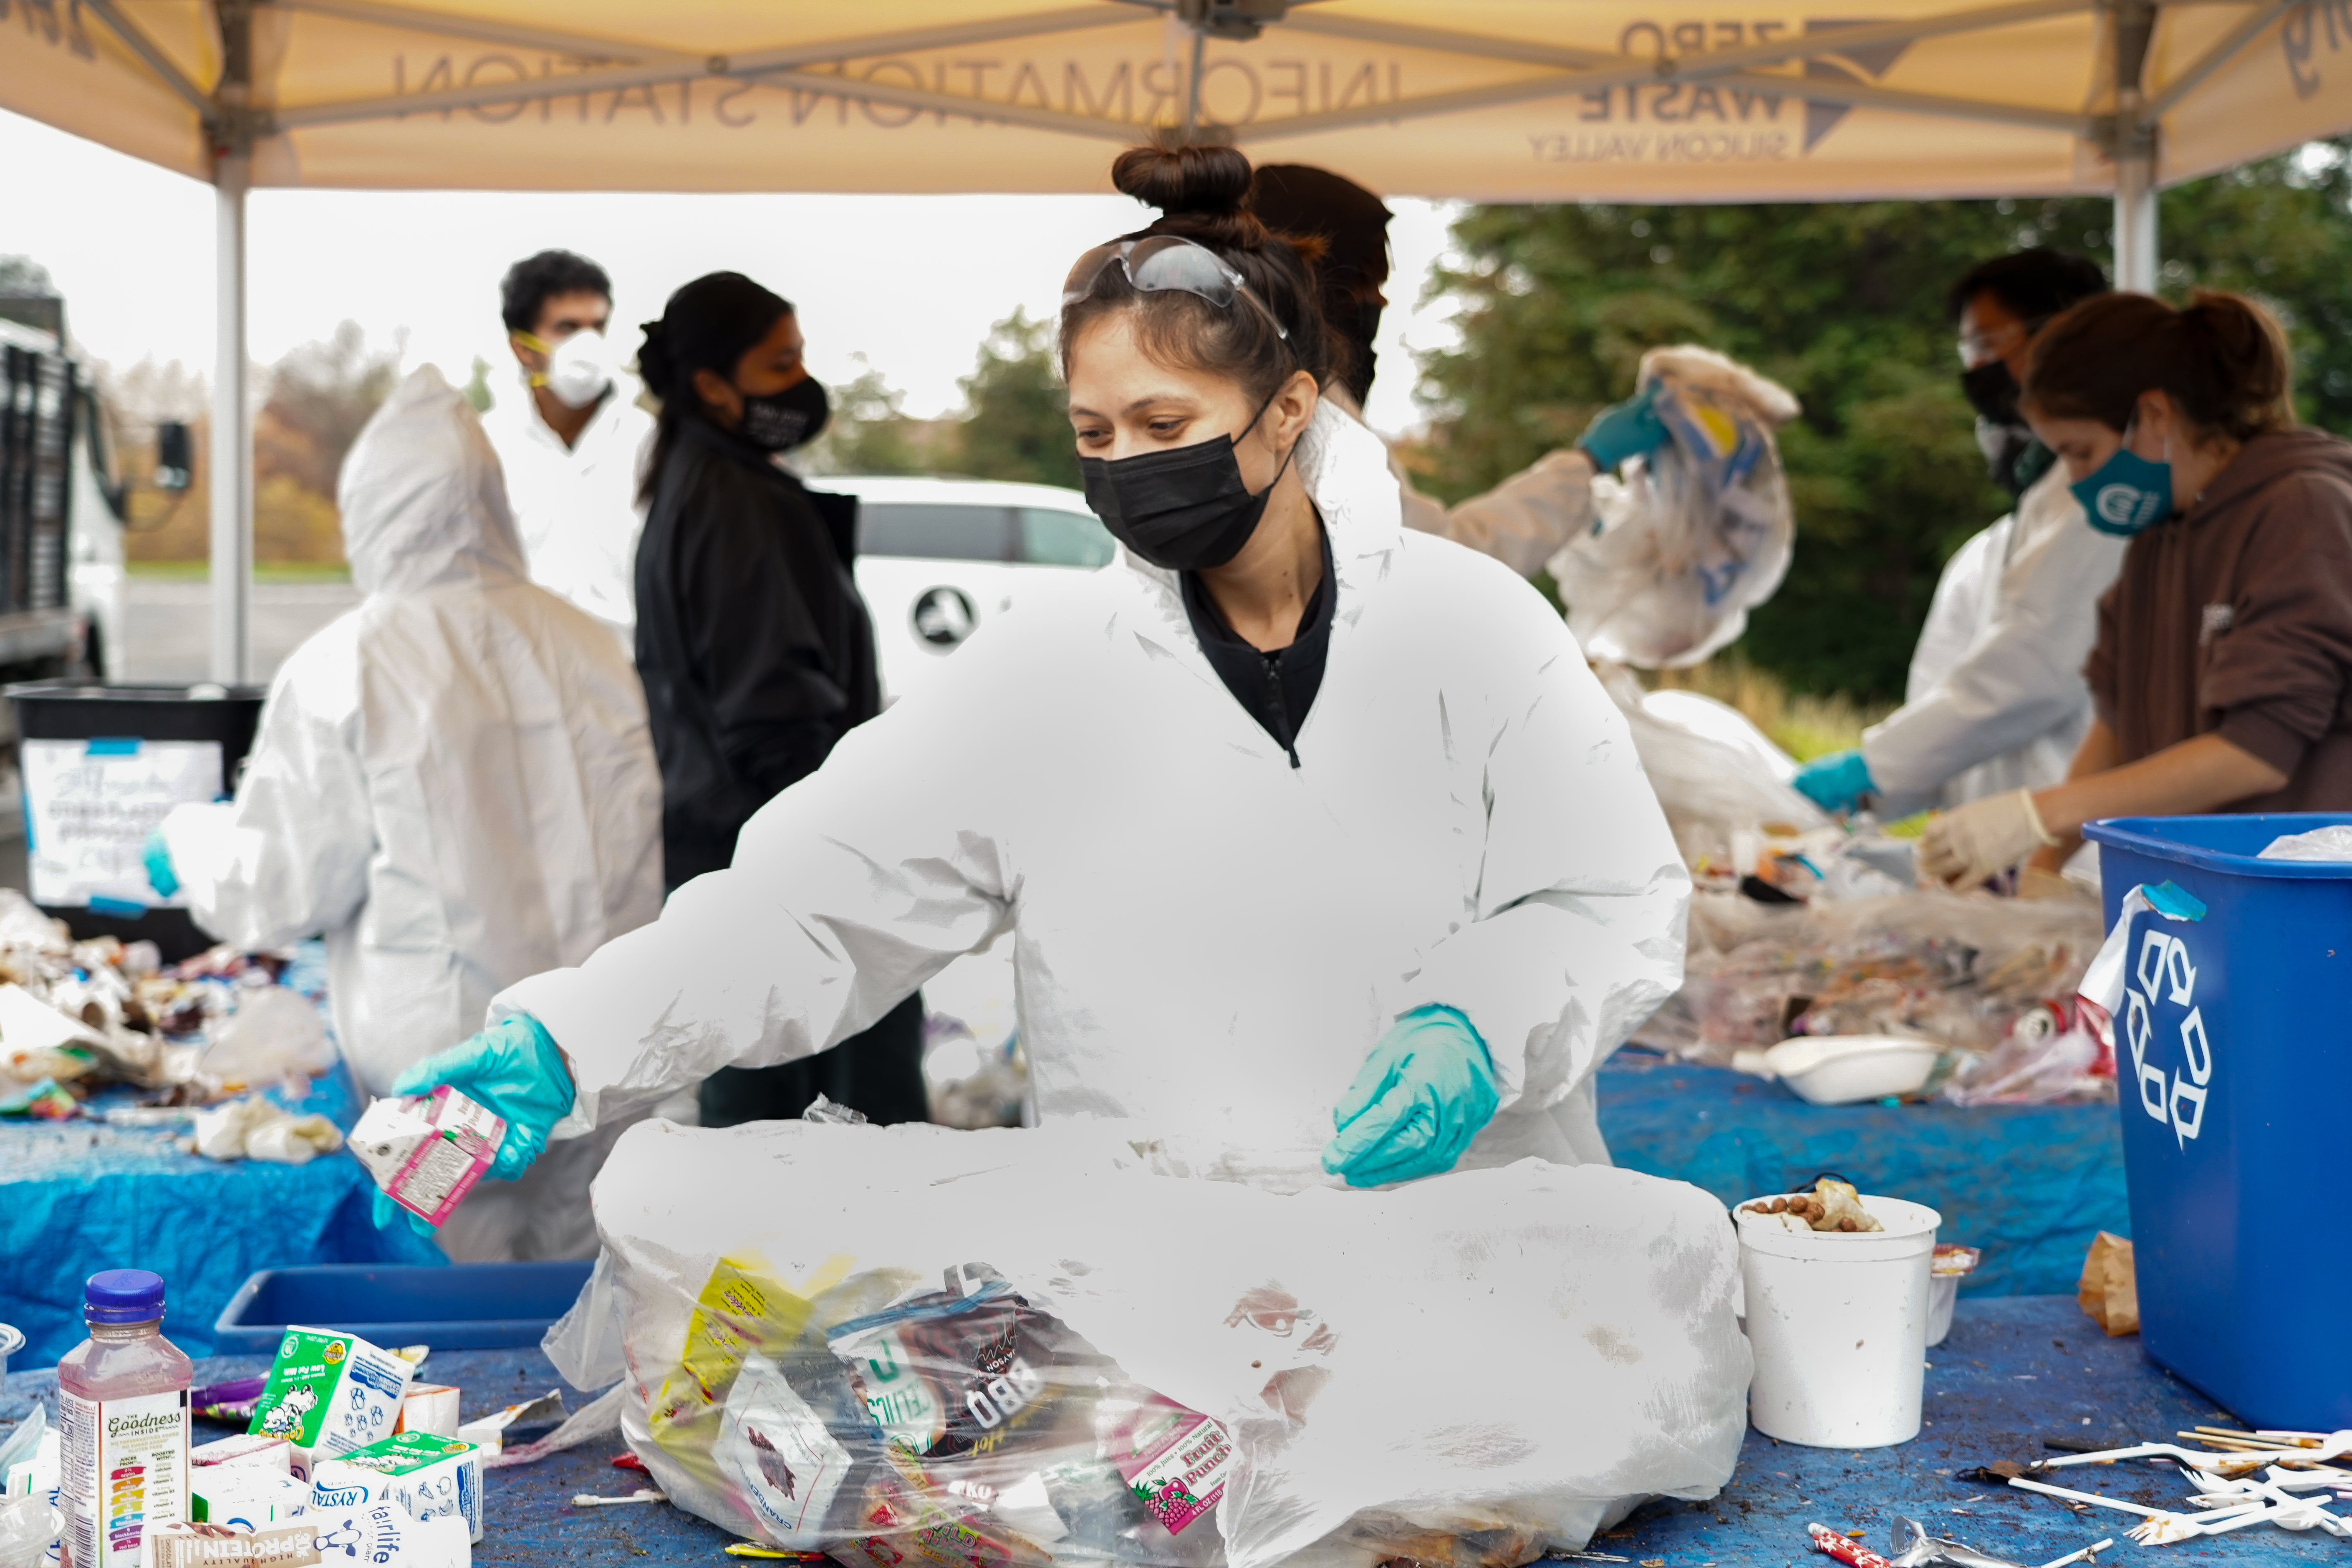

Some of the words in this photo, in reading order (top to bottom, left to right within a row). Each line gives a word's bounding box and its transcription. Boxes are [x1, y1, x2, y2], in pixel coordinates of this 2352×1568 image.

[310, 1364, 326, 1373] Low
[108, 1413, 181, 1438] Goodness
[131, 1428, 159, 1436] INSIDE
[1146, 1462, 1162, 1477] 100%
[1160, 1452, 1175, 1468] Juice
[1177, 1439, 1194, 1452] 100%
[1191, 1420, 1213, 1441] Natural
[1179, 1430, 1224, 1468] Fruit
[1182, 1443, 1233, 1487] Punch
[1209, 1476, 1221, 1487] from
[1195, 1504, 1204, 1515] FL
[1201, 1497, 1213, 1508] OZ
[204, 1534, 295, 1559] PROTEIN
[260, 1553, 293, 1565] HIGH
